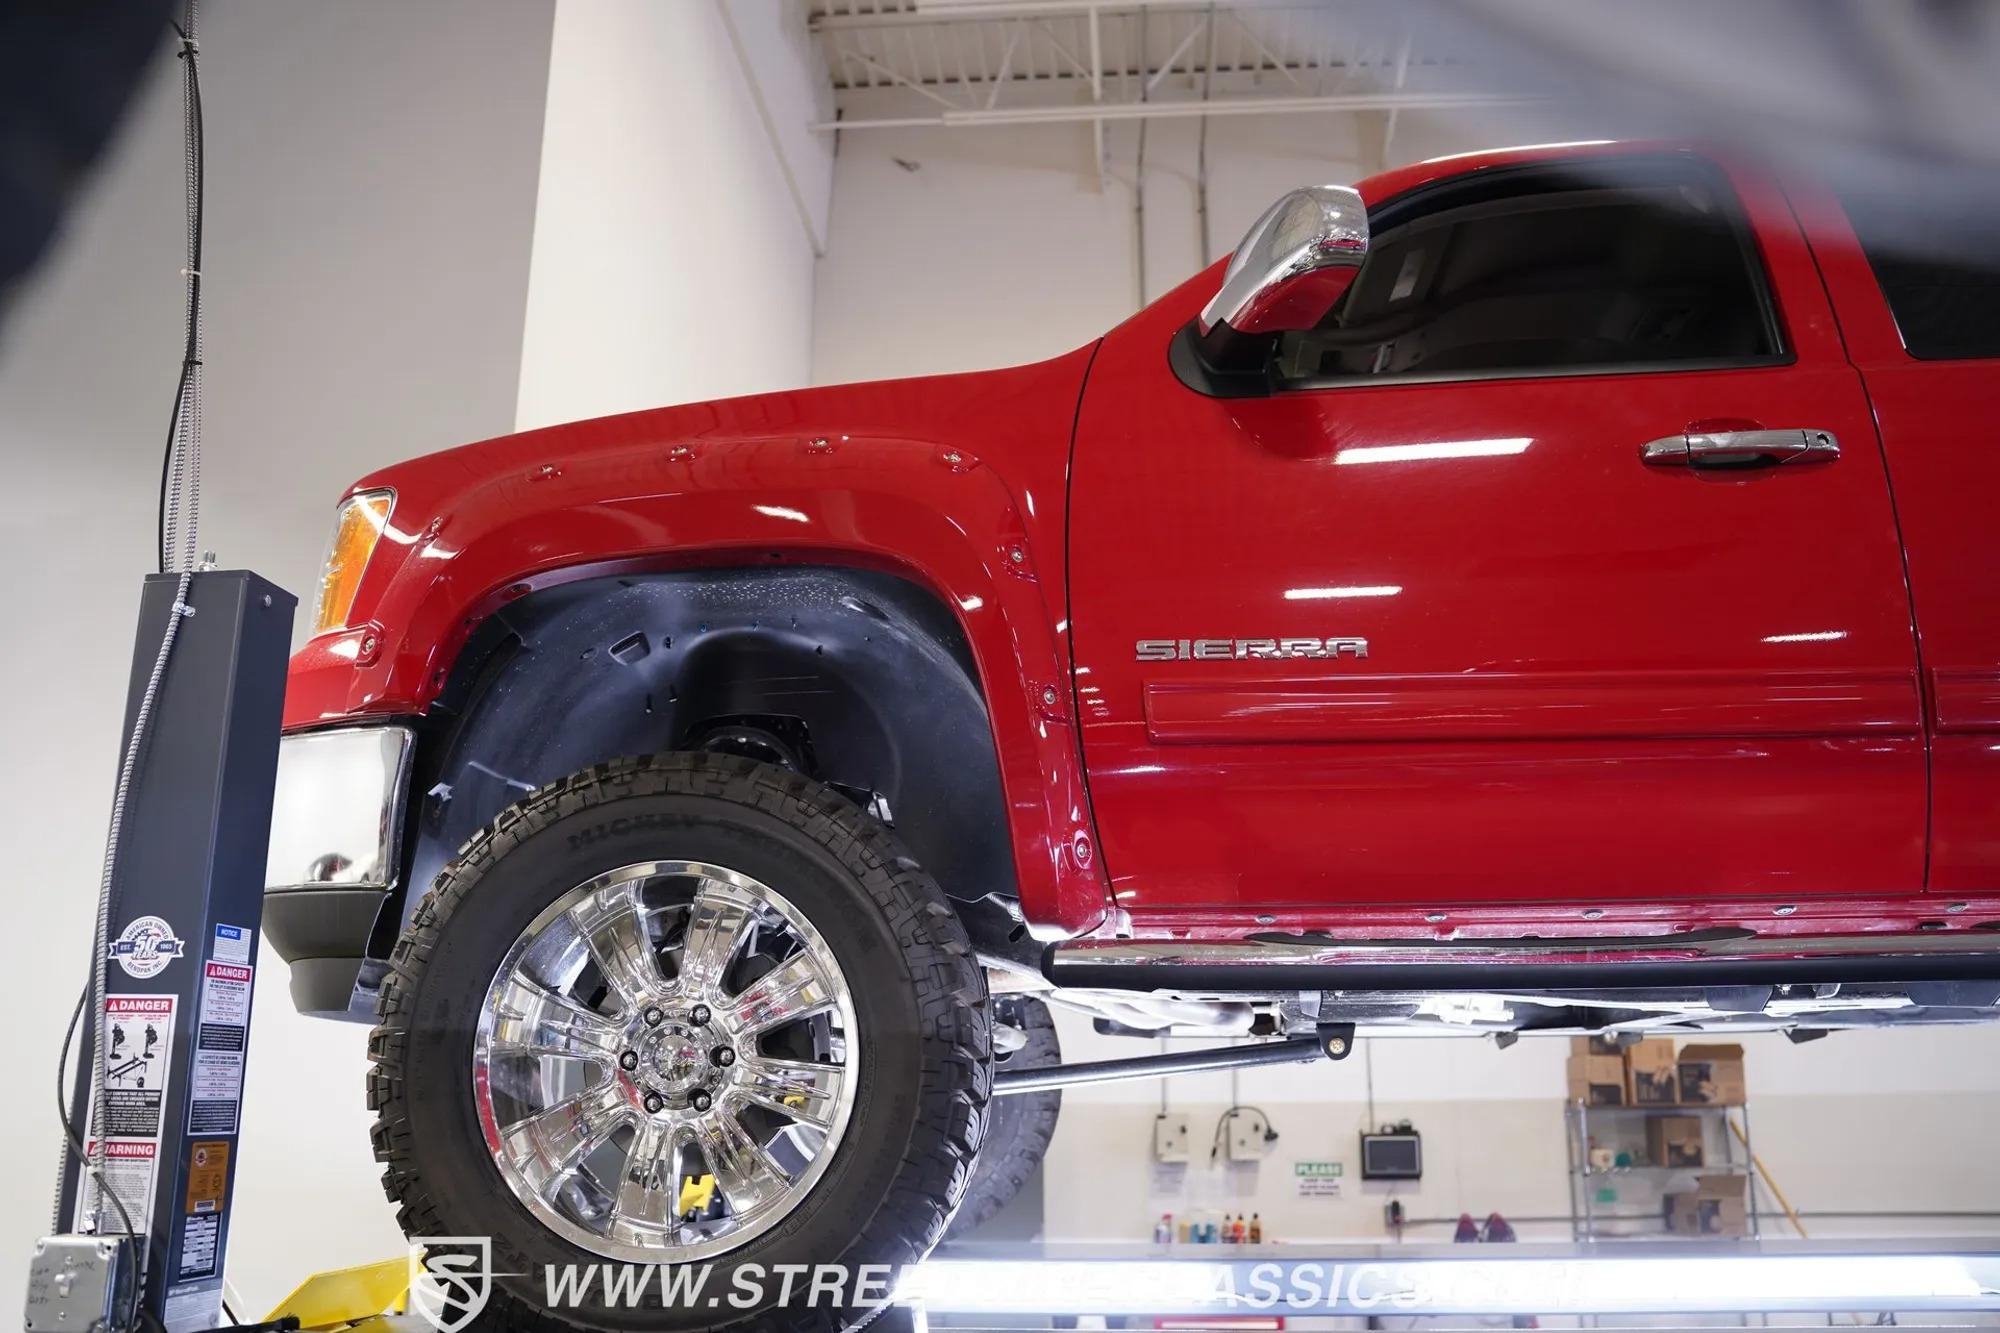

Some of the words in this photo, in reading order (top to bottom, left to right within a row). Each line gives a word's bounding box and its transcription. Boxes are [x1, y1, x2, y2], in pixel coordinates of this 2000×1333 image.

[1136, 637, 1368, 661] SIERRA
[135, 935, 160, 953] 50
[216, 966, 248, 980] DANGER
[119, 1000, 170, 1011] DANGER
